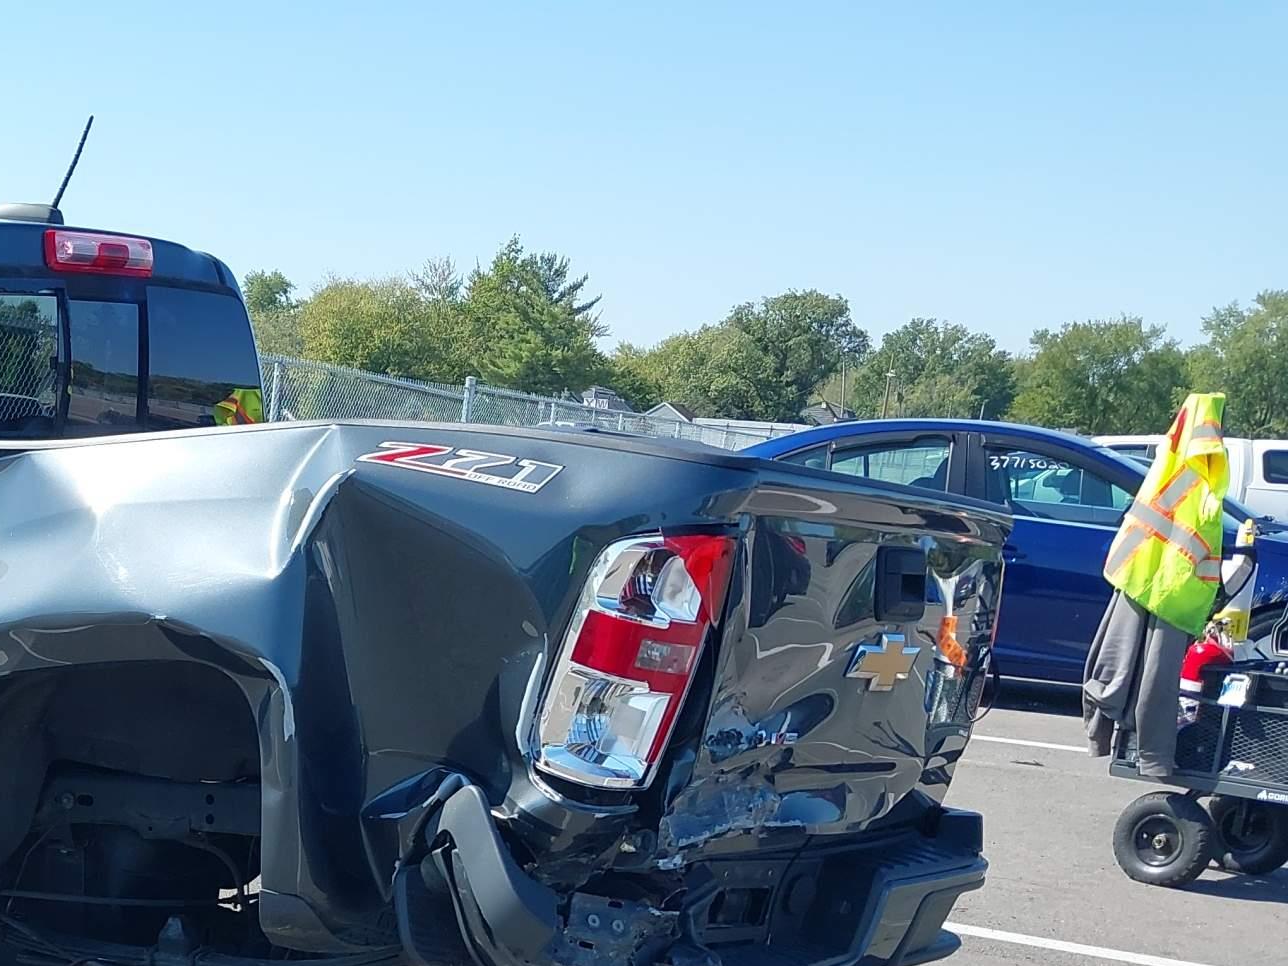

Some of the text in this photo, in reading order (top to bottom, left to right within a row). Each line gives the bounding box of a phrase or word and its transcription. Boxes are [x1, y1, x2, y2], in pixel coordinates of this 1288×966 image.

[356, 440, 566, 489] Z71
[467, 473, 538, 491] OFF ROAD
